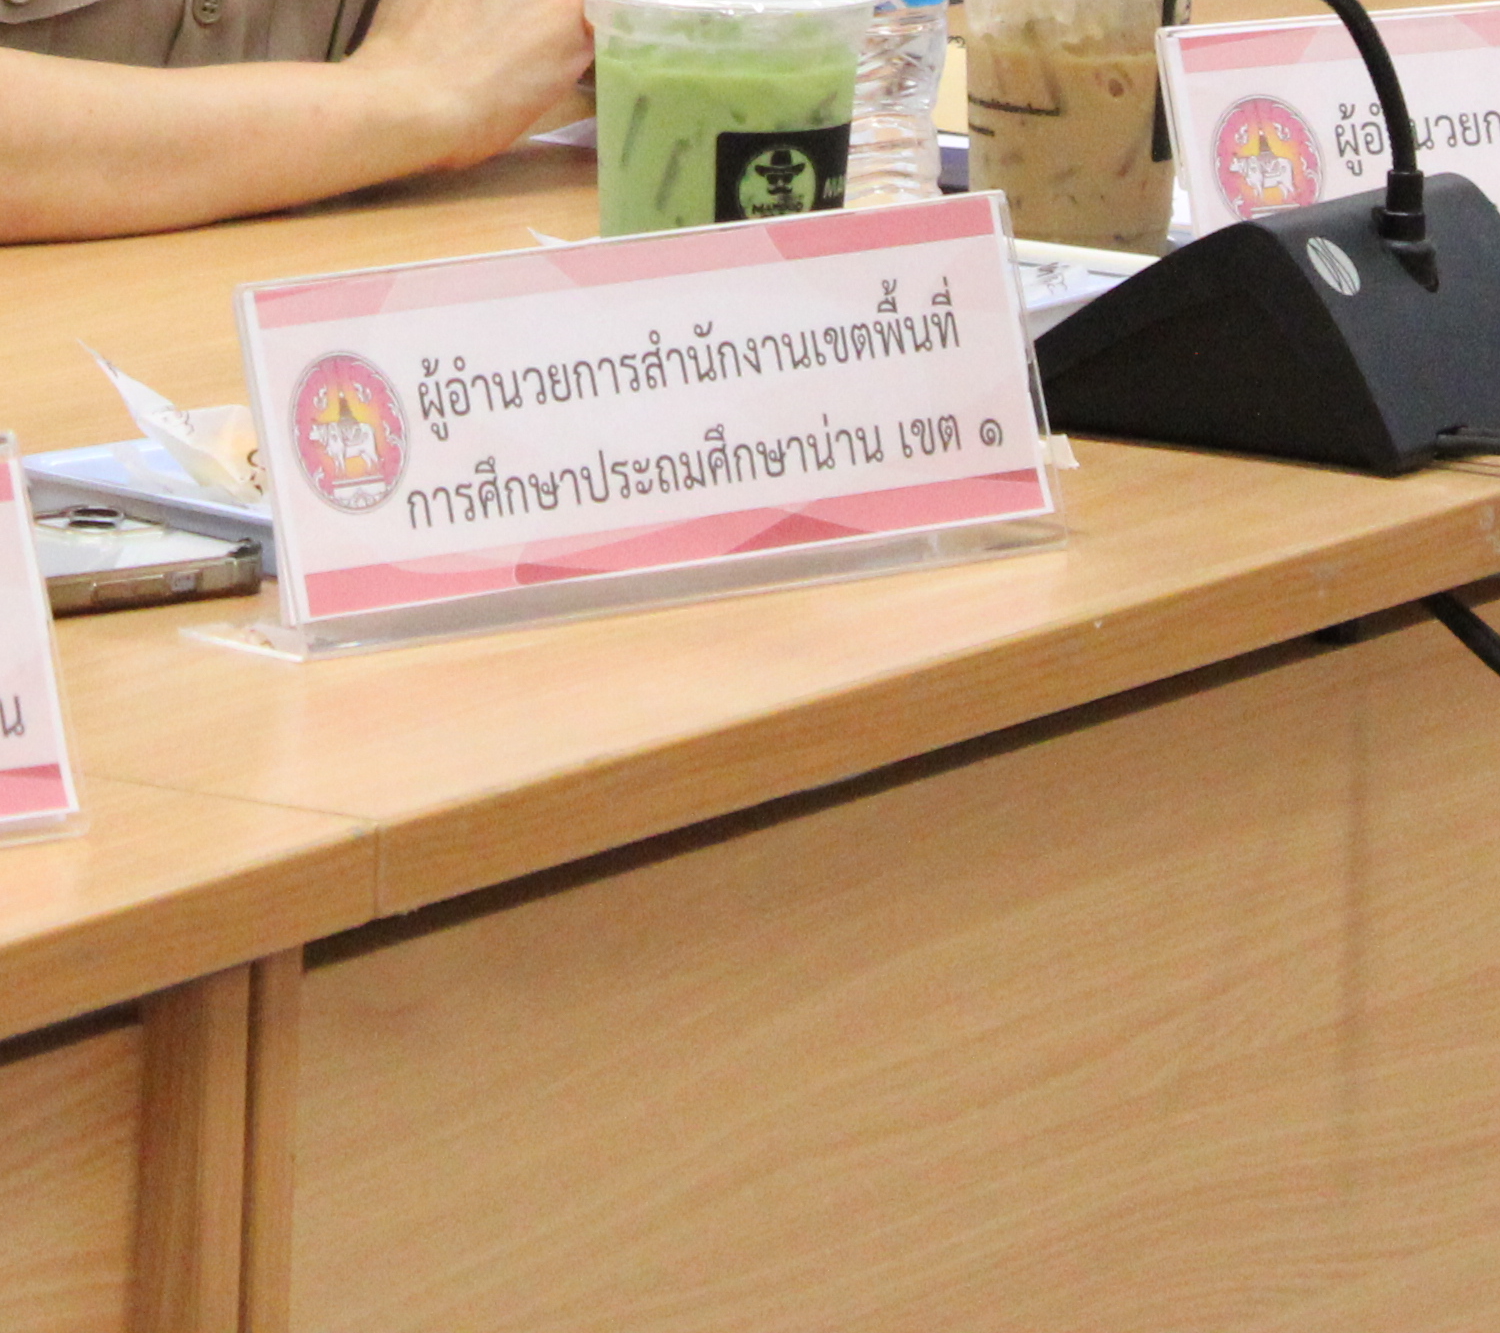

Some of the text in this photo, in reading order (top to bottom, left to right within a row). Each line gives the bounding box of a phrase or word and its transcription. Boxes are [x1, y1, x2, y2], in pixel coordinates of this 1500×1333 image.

[417, 277, 962, 442] ผู้อำนวยการสำนักงานเขตพื้นที่
[405, 408, 1005, 529] การศึกษาประถมศึกษาน่าน เขต ๑
